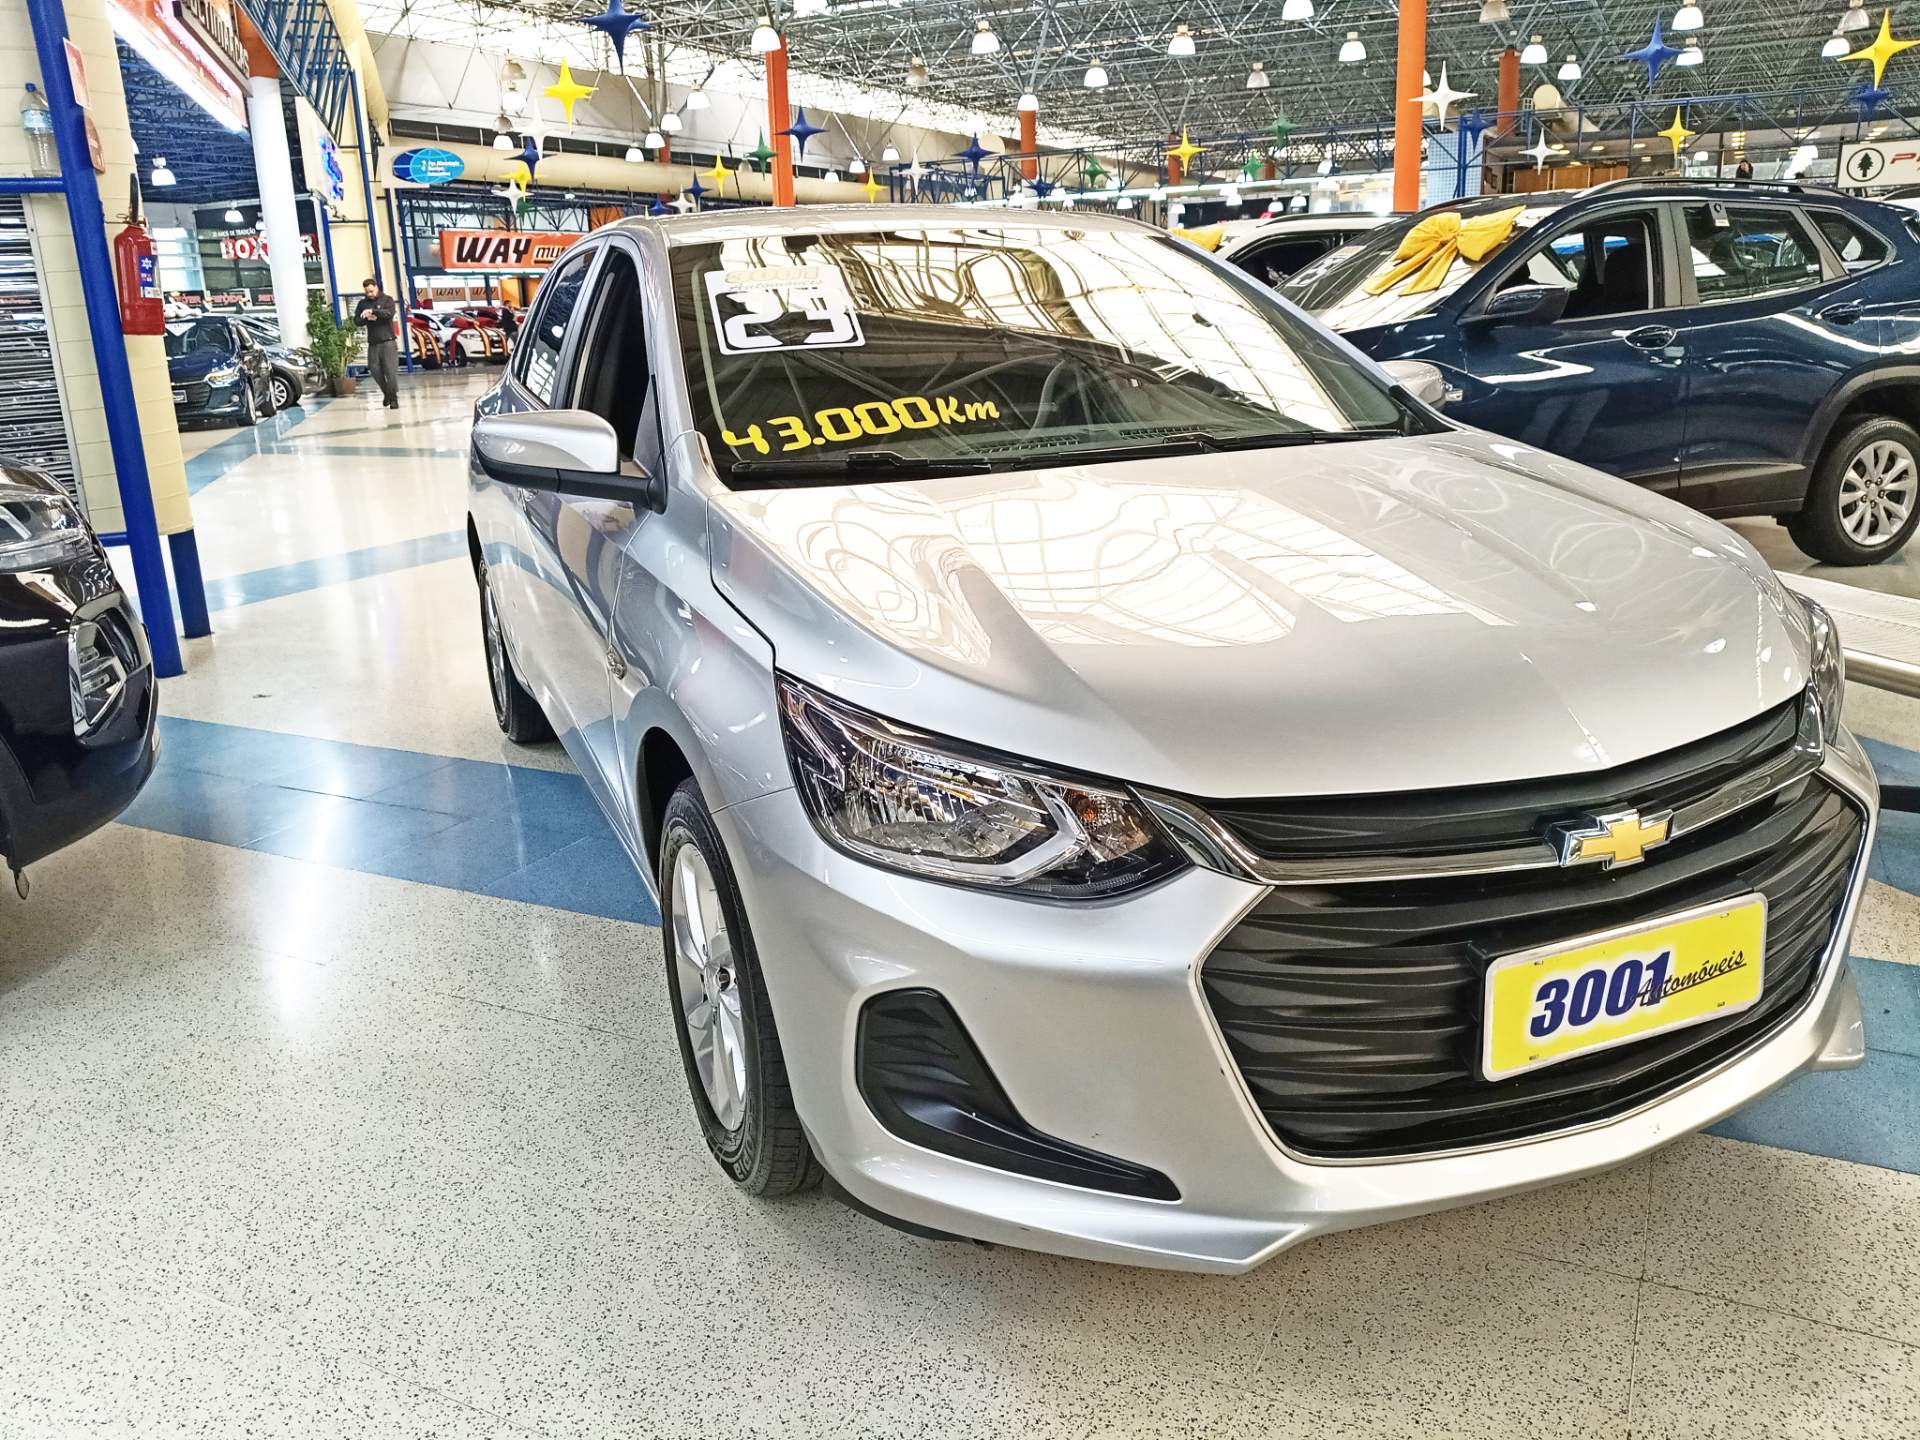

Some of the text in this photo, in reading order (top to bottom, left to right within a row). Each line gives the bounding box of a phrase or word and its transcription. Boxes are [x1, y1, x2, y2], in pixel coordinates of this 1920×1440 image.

[456, 237, 531, 264] WAY
[436, 288, 461, 297] WAY
[1530, 949, 1747, 1038] 3001 Automóveis
